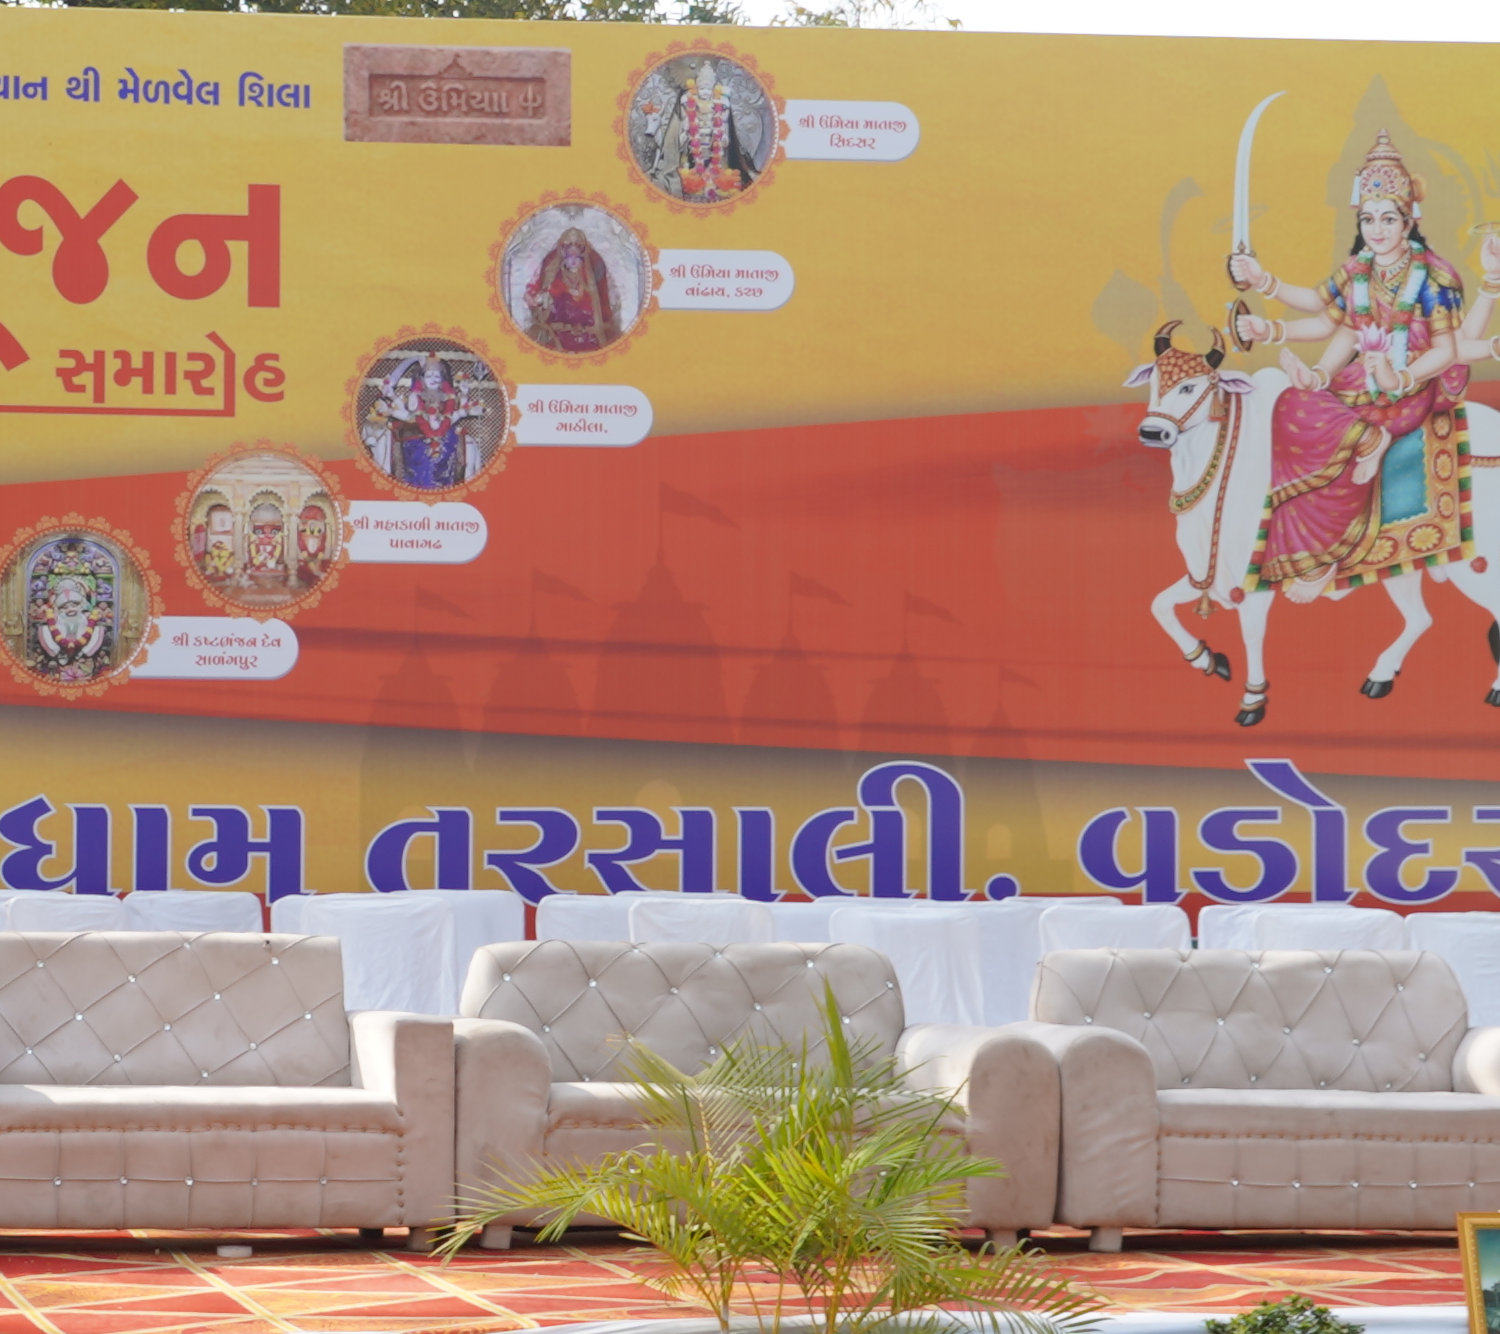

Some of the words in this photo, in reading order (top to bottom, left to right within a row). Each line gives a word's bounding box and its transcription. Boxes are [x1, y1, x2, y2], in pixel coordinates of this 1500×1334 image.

[66, 66, 101, 103] થી
[117, 66, 220, 106] મેળવેલ
[238, 71, 312, 109] શિલા
[377, 81, 410, 111] શ્રી
[798, 114, 815, 129] શ્રી
[863, 119, 907, 133] માતાજી
[669, 264, 686, 279] શ્રી
[735, 269, 779, 282] માતાજી
[55, 331, 287, 415] સમારોહ
[527, 399, 544, 414] શ્રી
[593, 404, 637, 417] માતાજી
[352, 516, 369, 531] શ્રી
[434, 520, 480, 534] માતાજી
[171, 632, 189, 647] શ્રી
[261, 633, 281, 648] દેવ
